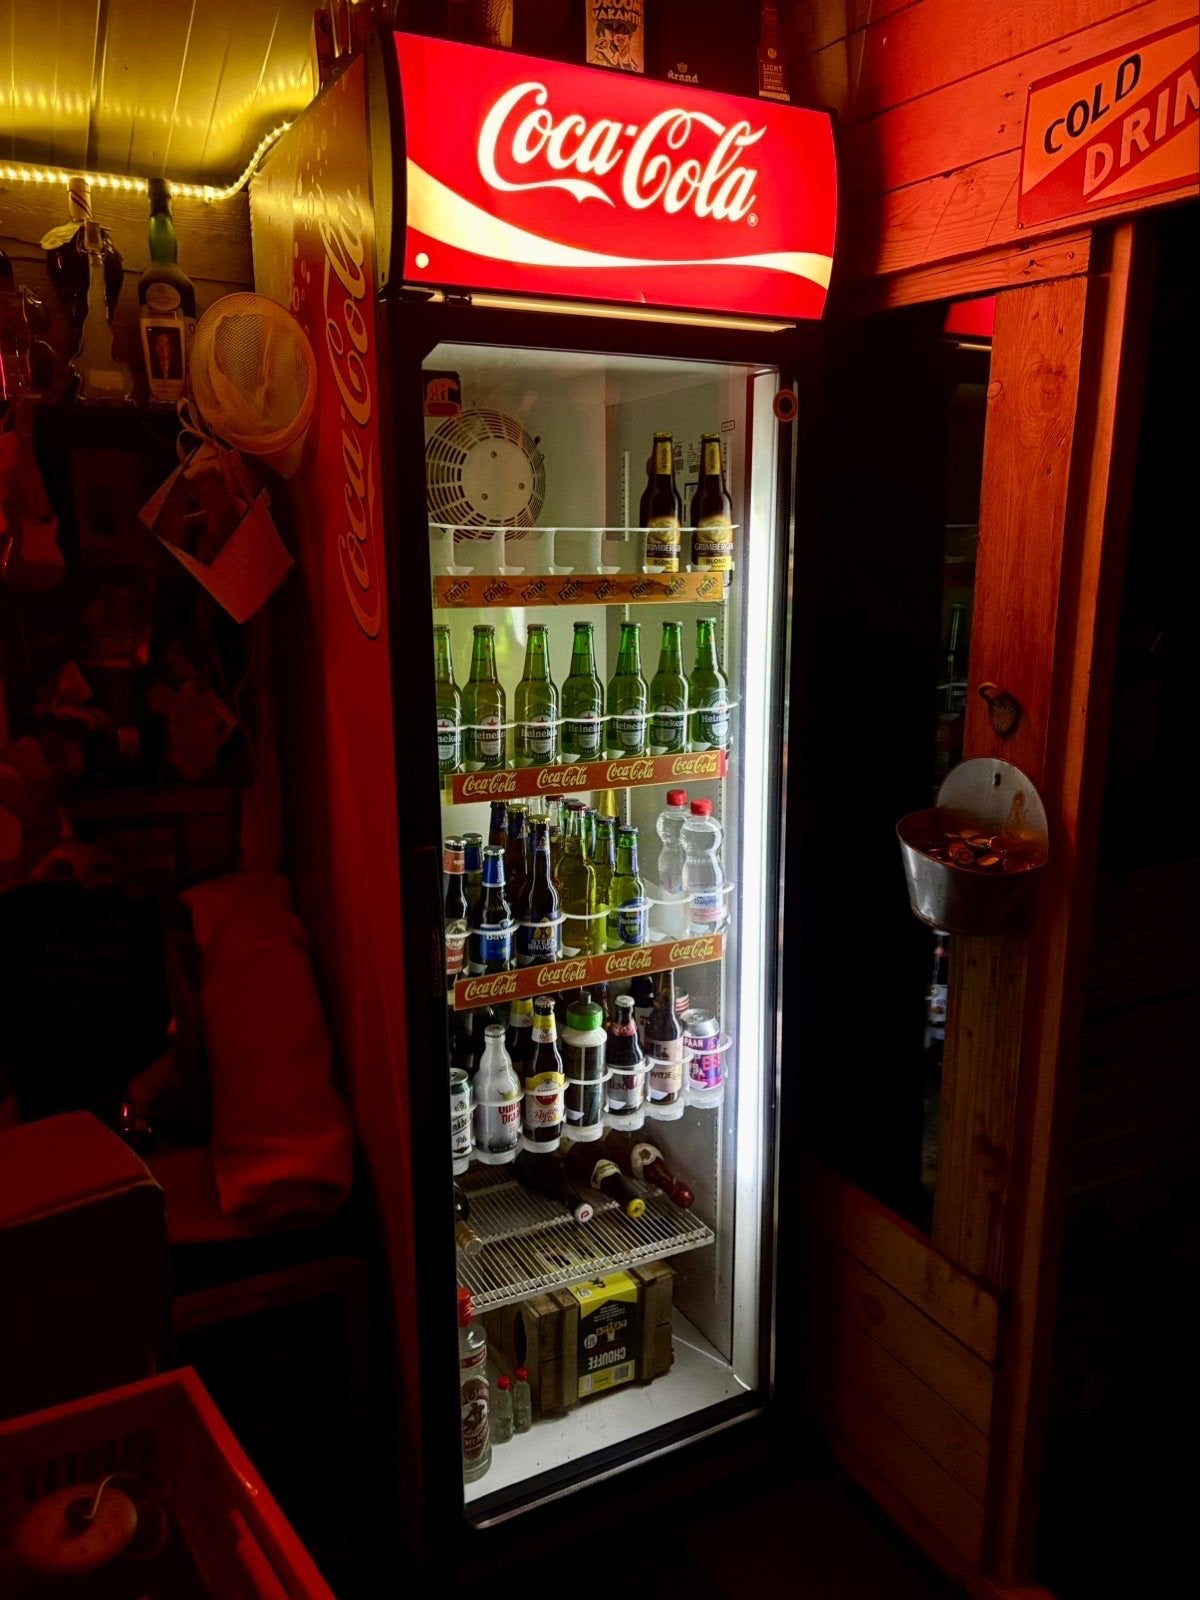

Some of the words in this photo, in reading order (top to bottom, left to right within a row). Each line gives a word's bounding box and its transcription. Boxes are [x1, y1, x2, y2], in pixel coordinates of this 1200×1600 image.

[667, 69, 699, 83] Brand
[1043, 53, 1142, 155] COLD
[477, 81, 768, 223] Coca-Cola
[319, 183, 382, 639] Coca-Cola
[706, 557, 727, 565] BLOND
[537, 765, 588, 789] Coca-Cola
[607, 759, 655, 783] Coca-Cola
[671, 753, 718, 776] Coca-Cola
[462, 771, 518, 796] Coca-Cola
[606, 950, 653, 974] Coca-Cola
[670, 937, 715, 962] Coca-Cola
[537, 959, 587, 985] Coca-Cola
[464, 973, 518, 1002] Coca-Cola
[588, 1346, 627, 1371] CHOUFFE
